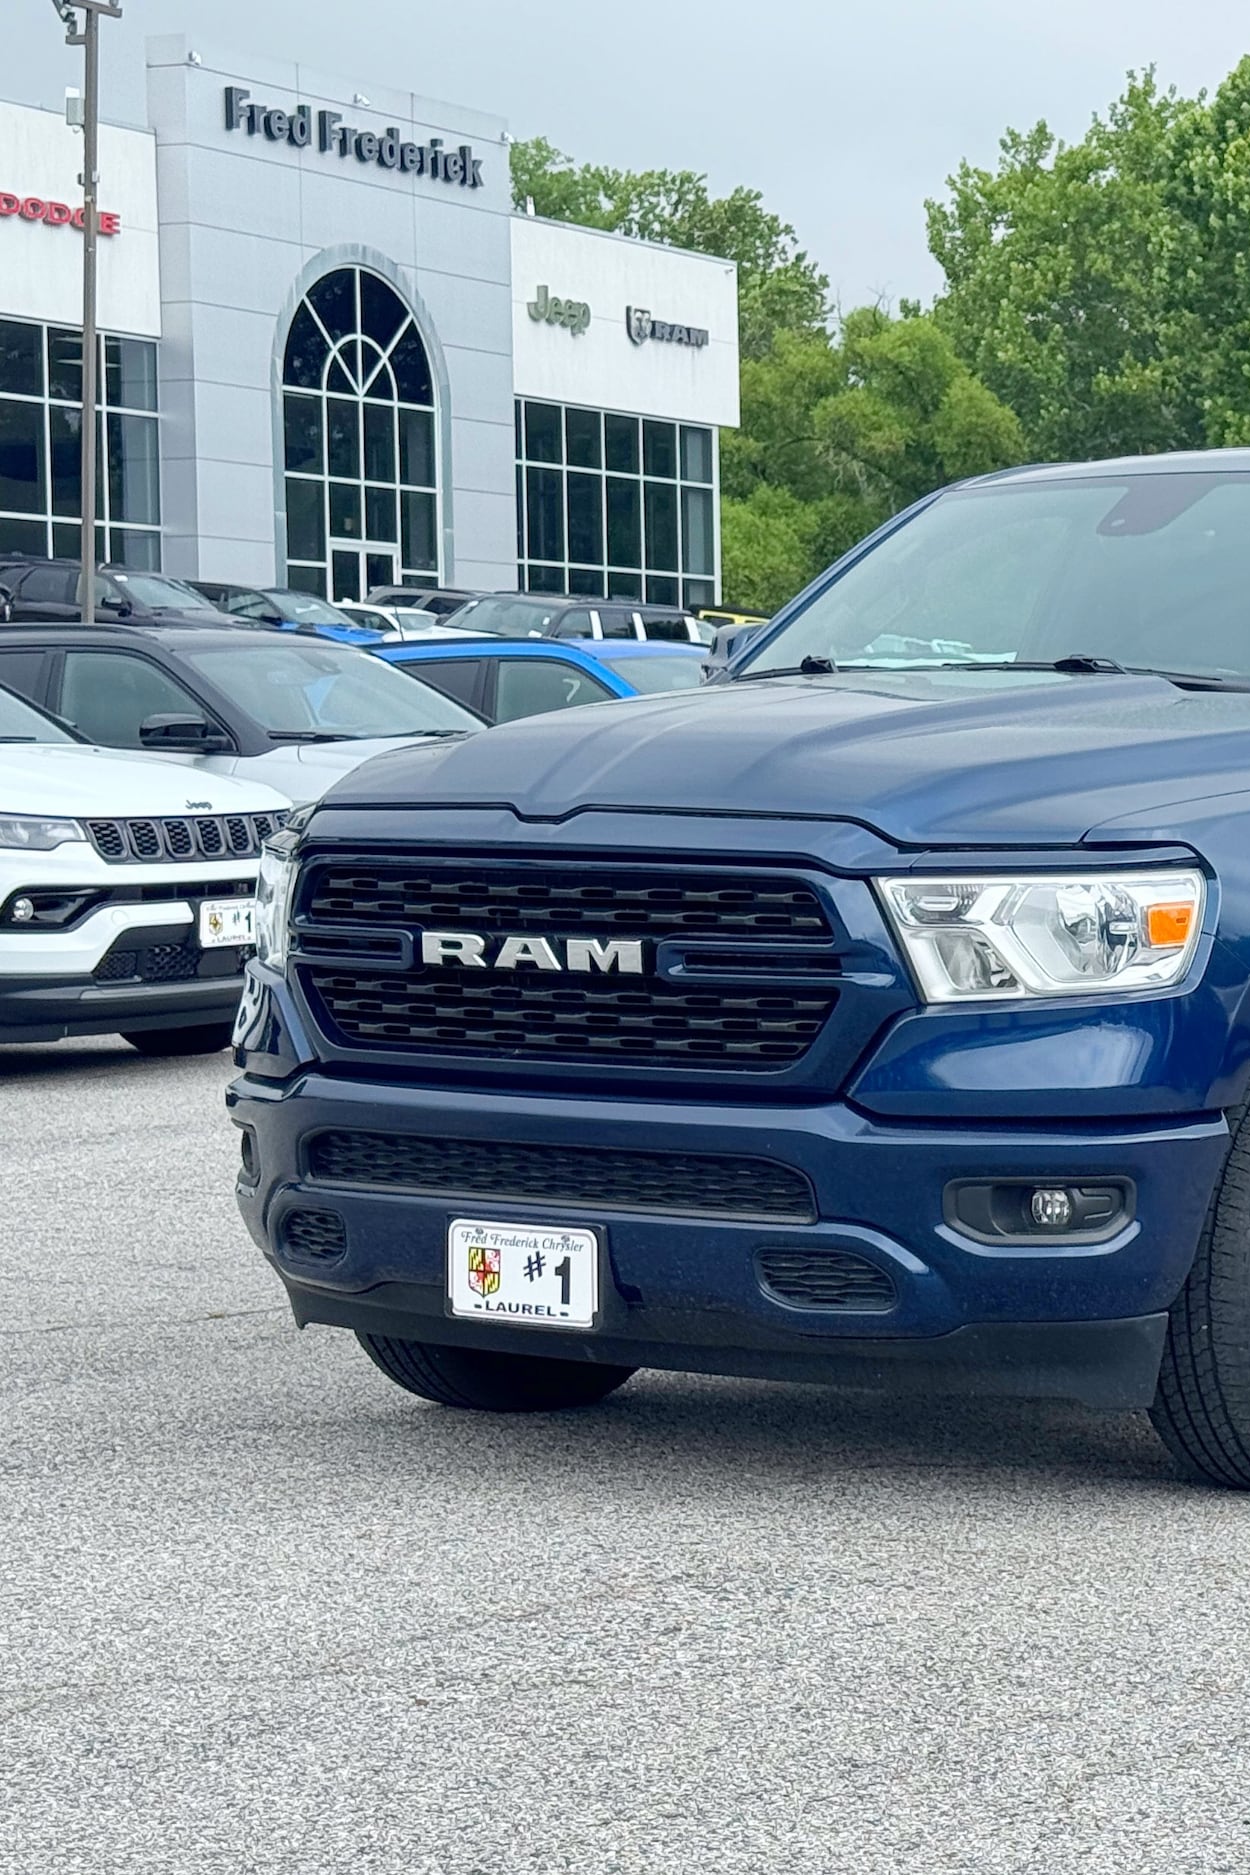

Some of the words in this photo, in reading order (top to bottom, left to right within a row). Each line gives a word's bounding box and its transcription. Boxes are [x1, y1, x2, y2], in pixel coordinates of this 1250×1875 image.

[225, 86, 311, 147] Fred
[318, 110, 484, 188] Frederick
[527, 285, 591, 336] Jeep
[650, 320, 709, 348] RAM
[421, 931, 643, 974] RAM
[461, 1229, 487, 1243] Fred
[490, 1233, 539, 1249] Frederick
[542, 1236, 584, 1252] Chrysler
